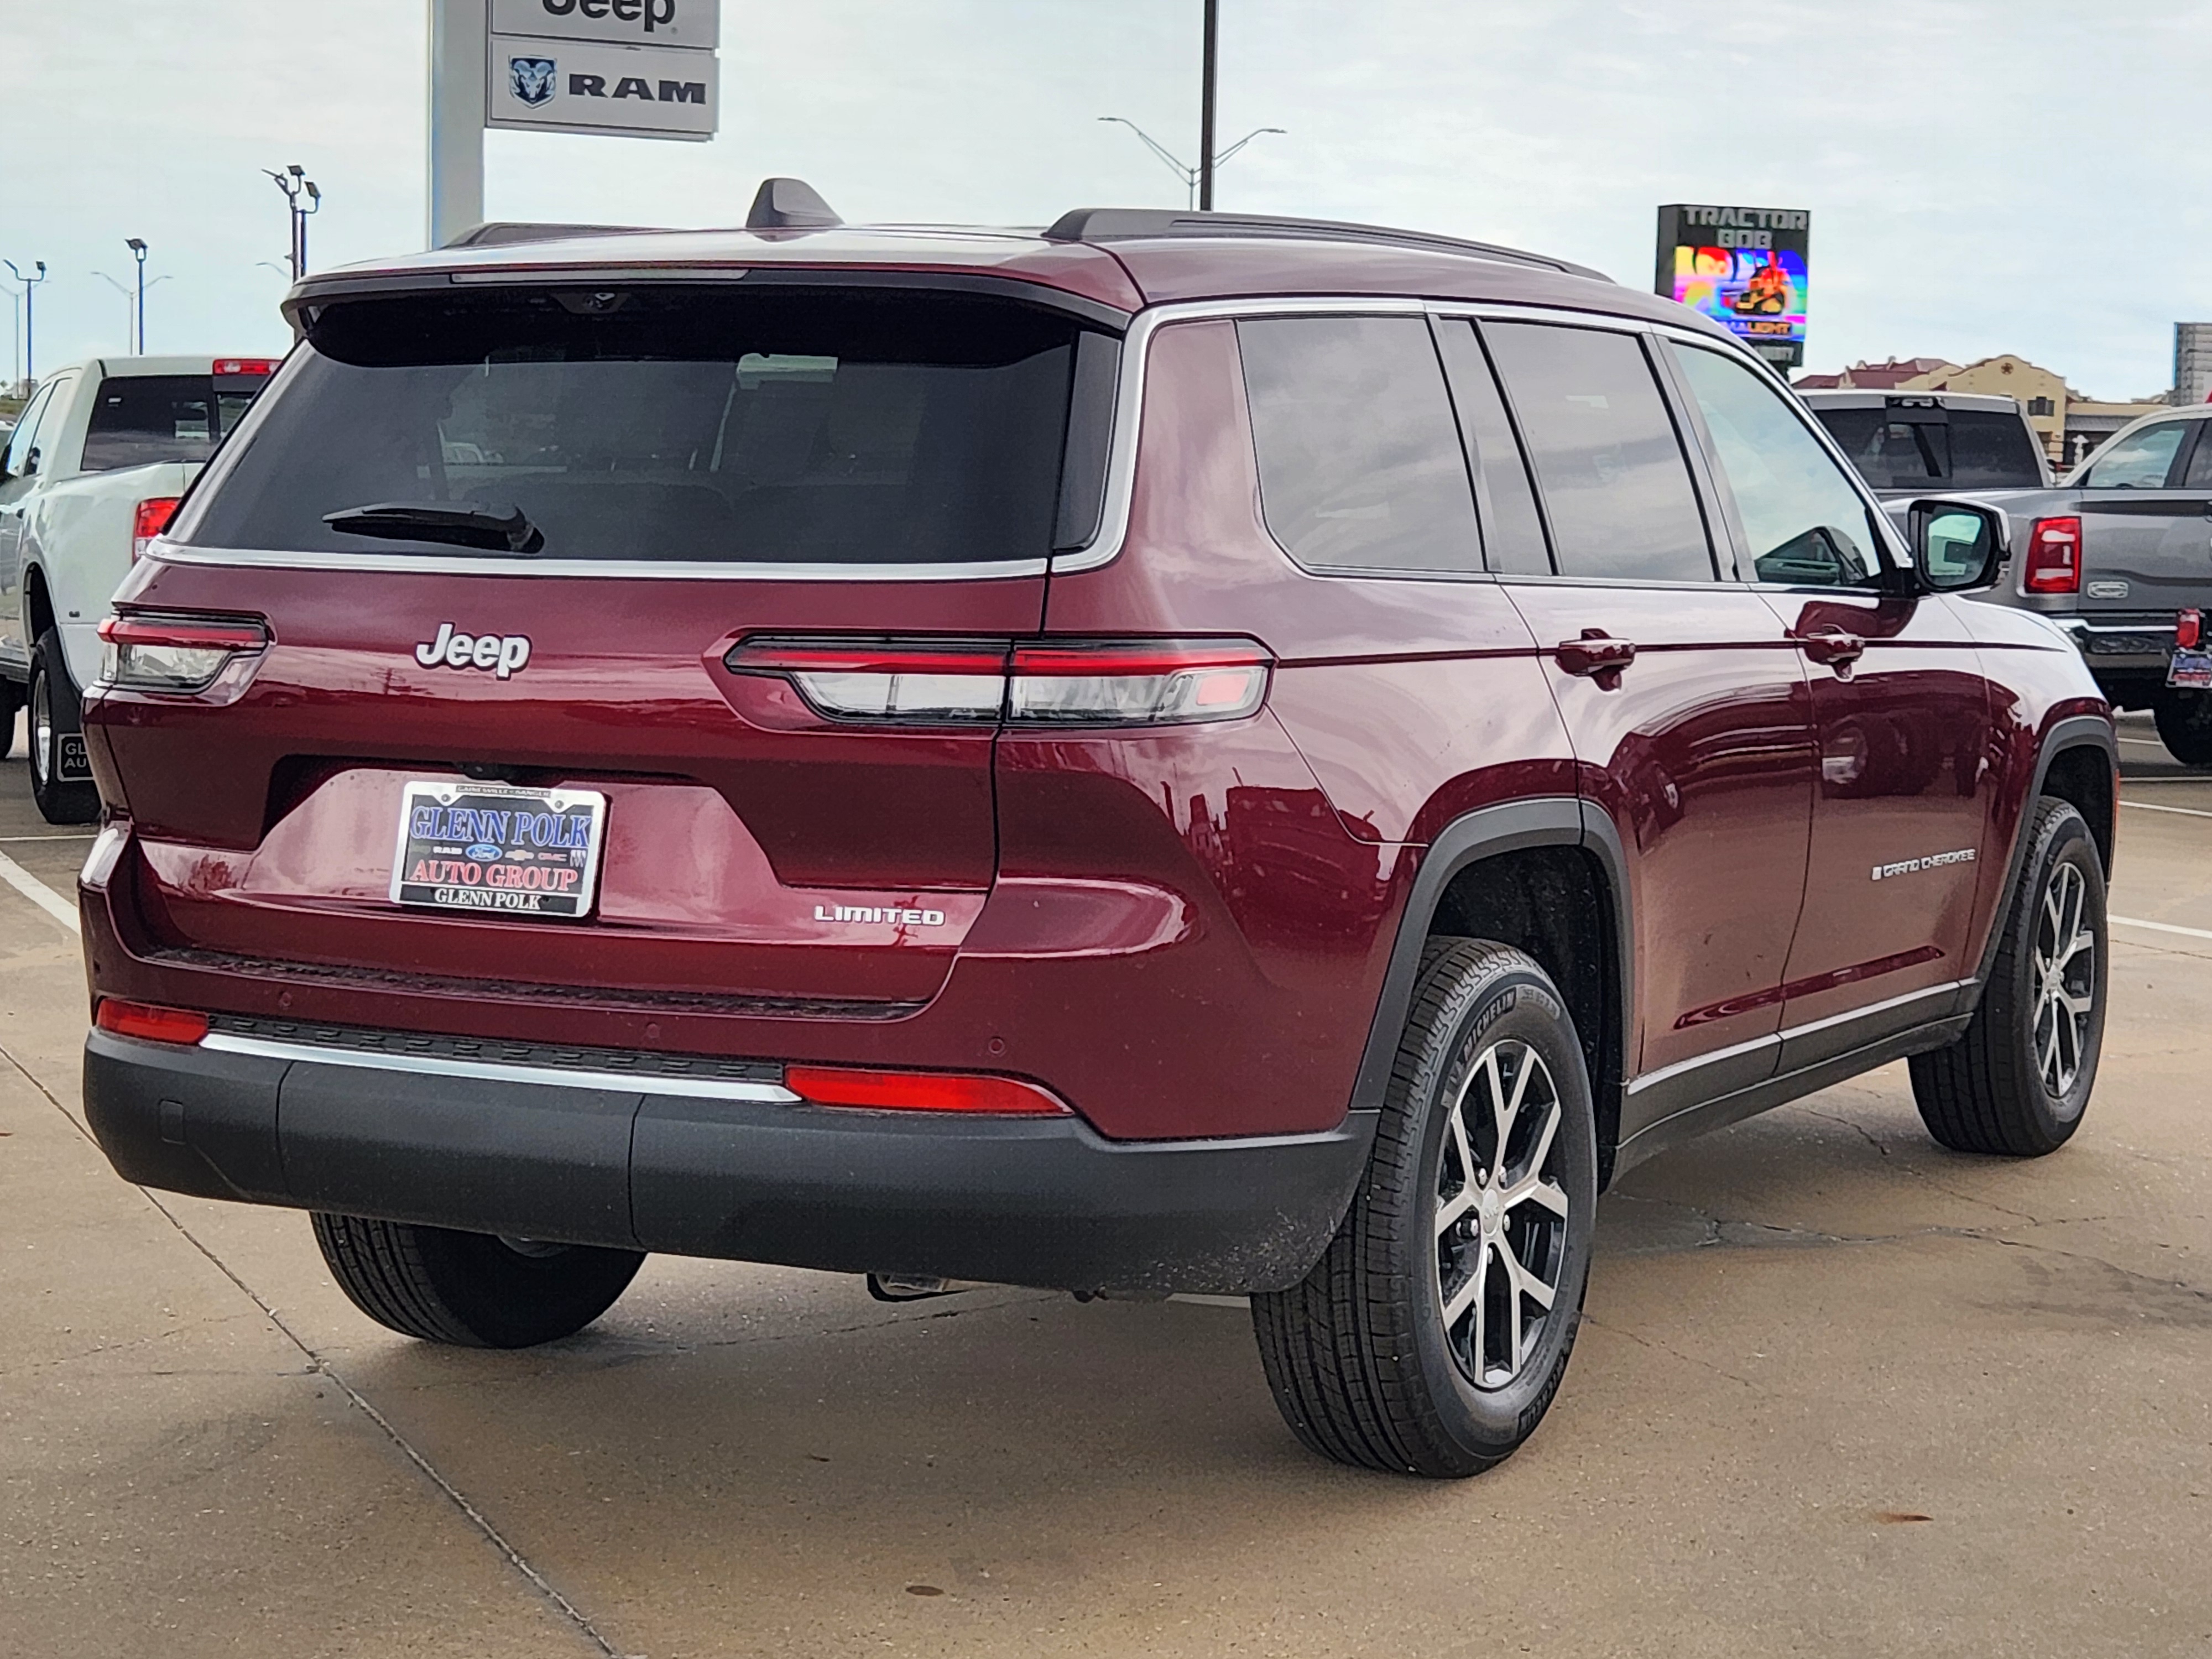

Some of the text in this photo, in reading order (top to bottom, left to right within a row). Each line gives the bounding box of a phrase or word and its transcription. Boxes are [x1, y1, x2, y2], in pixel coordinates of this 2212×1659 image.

[569, 73, 706, 105] RAM
[1683, 206, 1807, 230] TRACTOR
[416, 623, 530, 678] Jeep
[410, 806, 593, 848] GLENN POLK
[410, 859, 578, 891] AUTO GROUP
[1883, 848, 1976, 877] GRAND CHEROKEE
[435, 888, 541, 910] GLENN POLK
[815, 905, 945, 926] LIMITED
[1463, 990, 1516, 1061] MICHELIN
